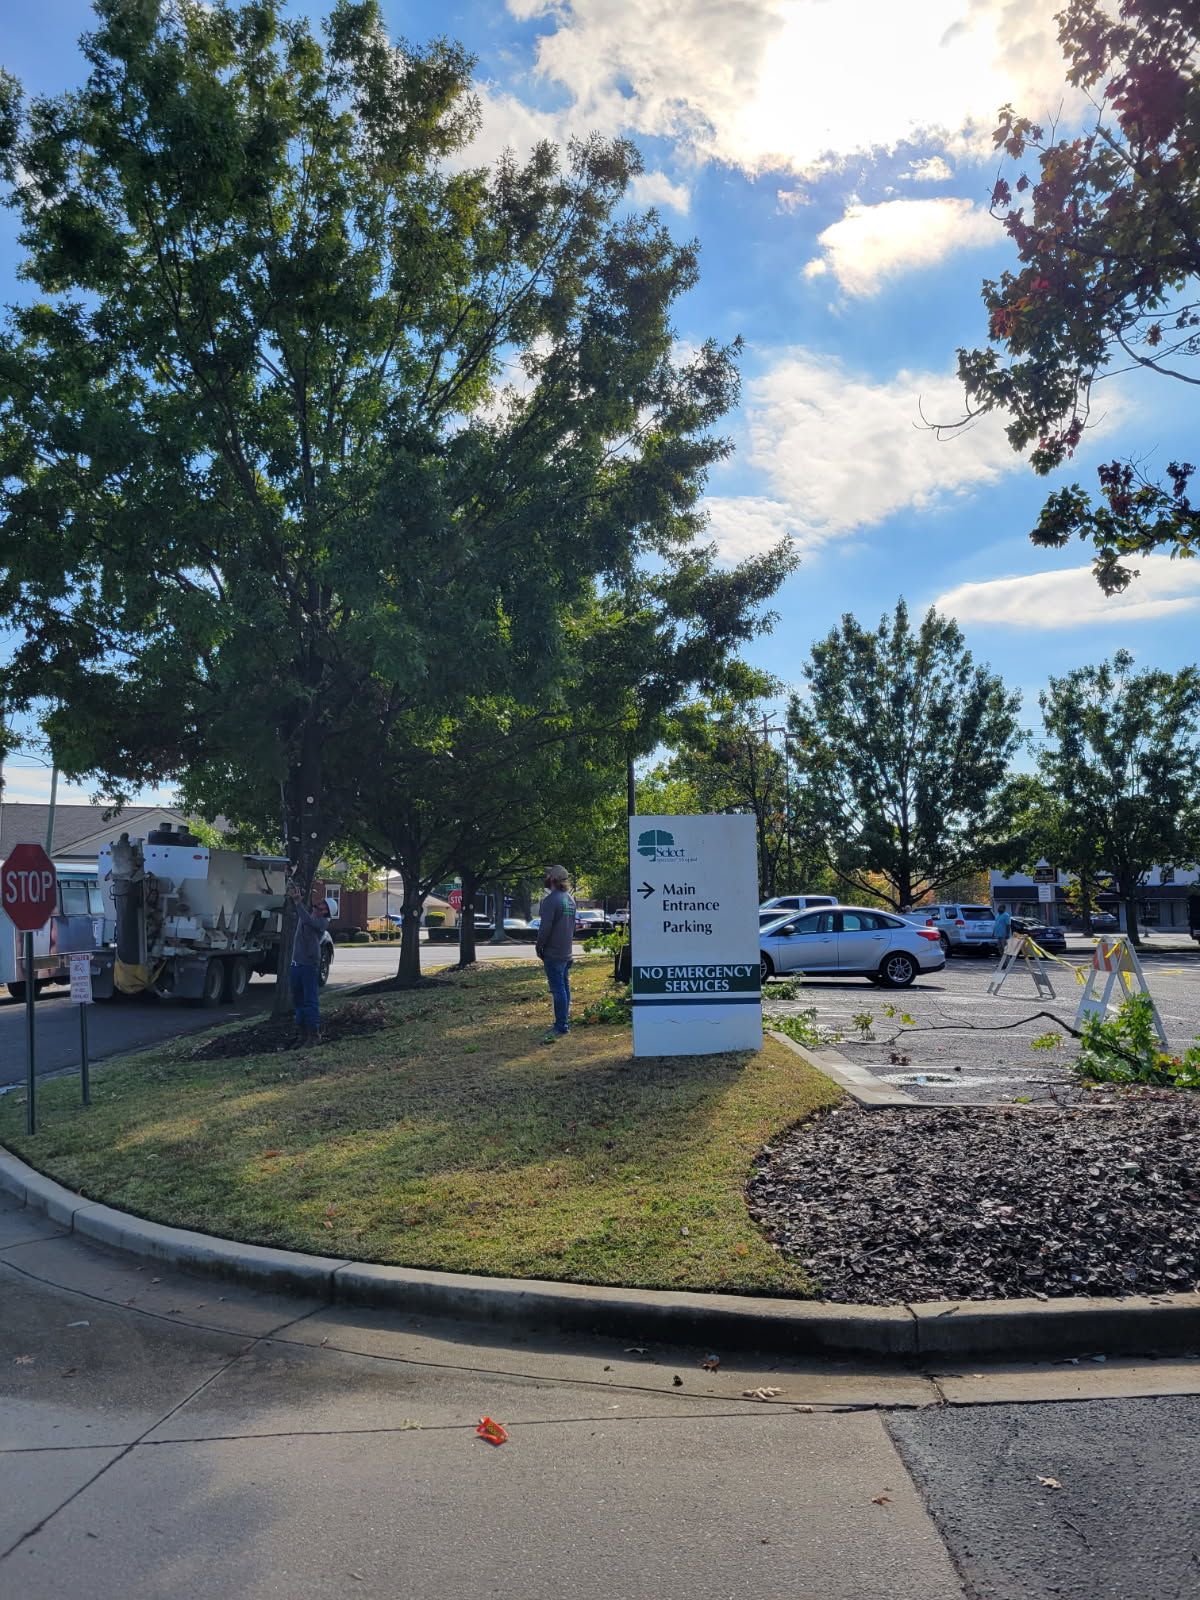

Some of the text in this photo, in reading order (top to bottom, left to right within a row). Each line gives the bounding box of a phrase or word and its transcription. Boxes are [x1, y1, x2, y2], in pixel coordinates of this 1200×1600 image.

[656, 847, 686, 858] Select
[6, 870, 53, 904] STOP
[662, 882, 696, 895] Main
[450, 896, 463, 904] STO
[662, 899, 720, 911] Entrance
[663, 920, 713, 936] Parking
[640, 965, 753, 979] NO EMERGENCY
[665, 979, 730, 992] SERVICES
